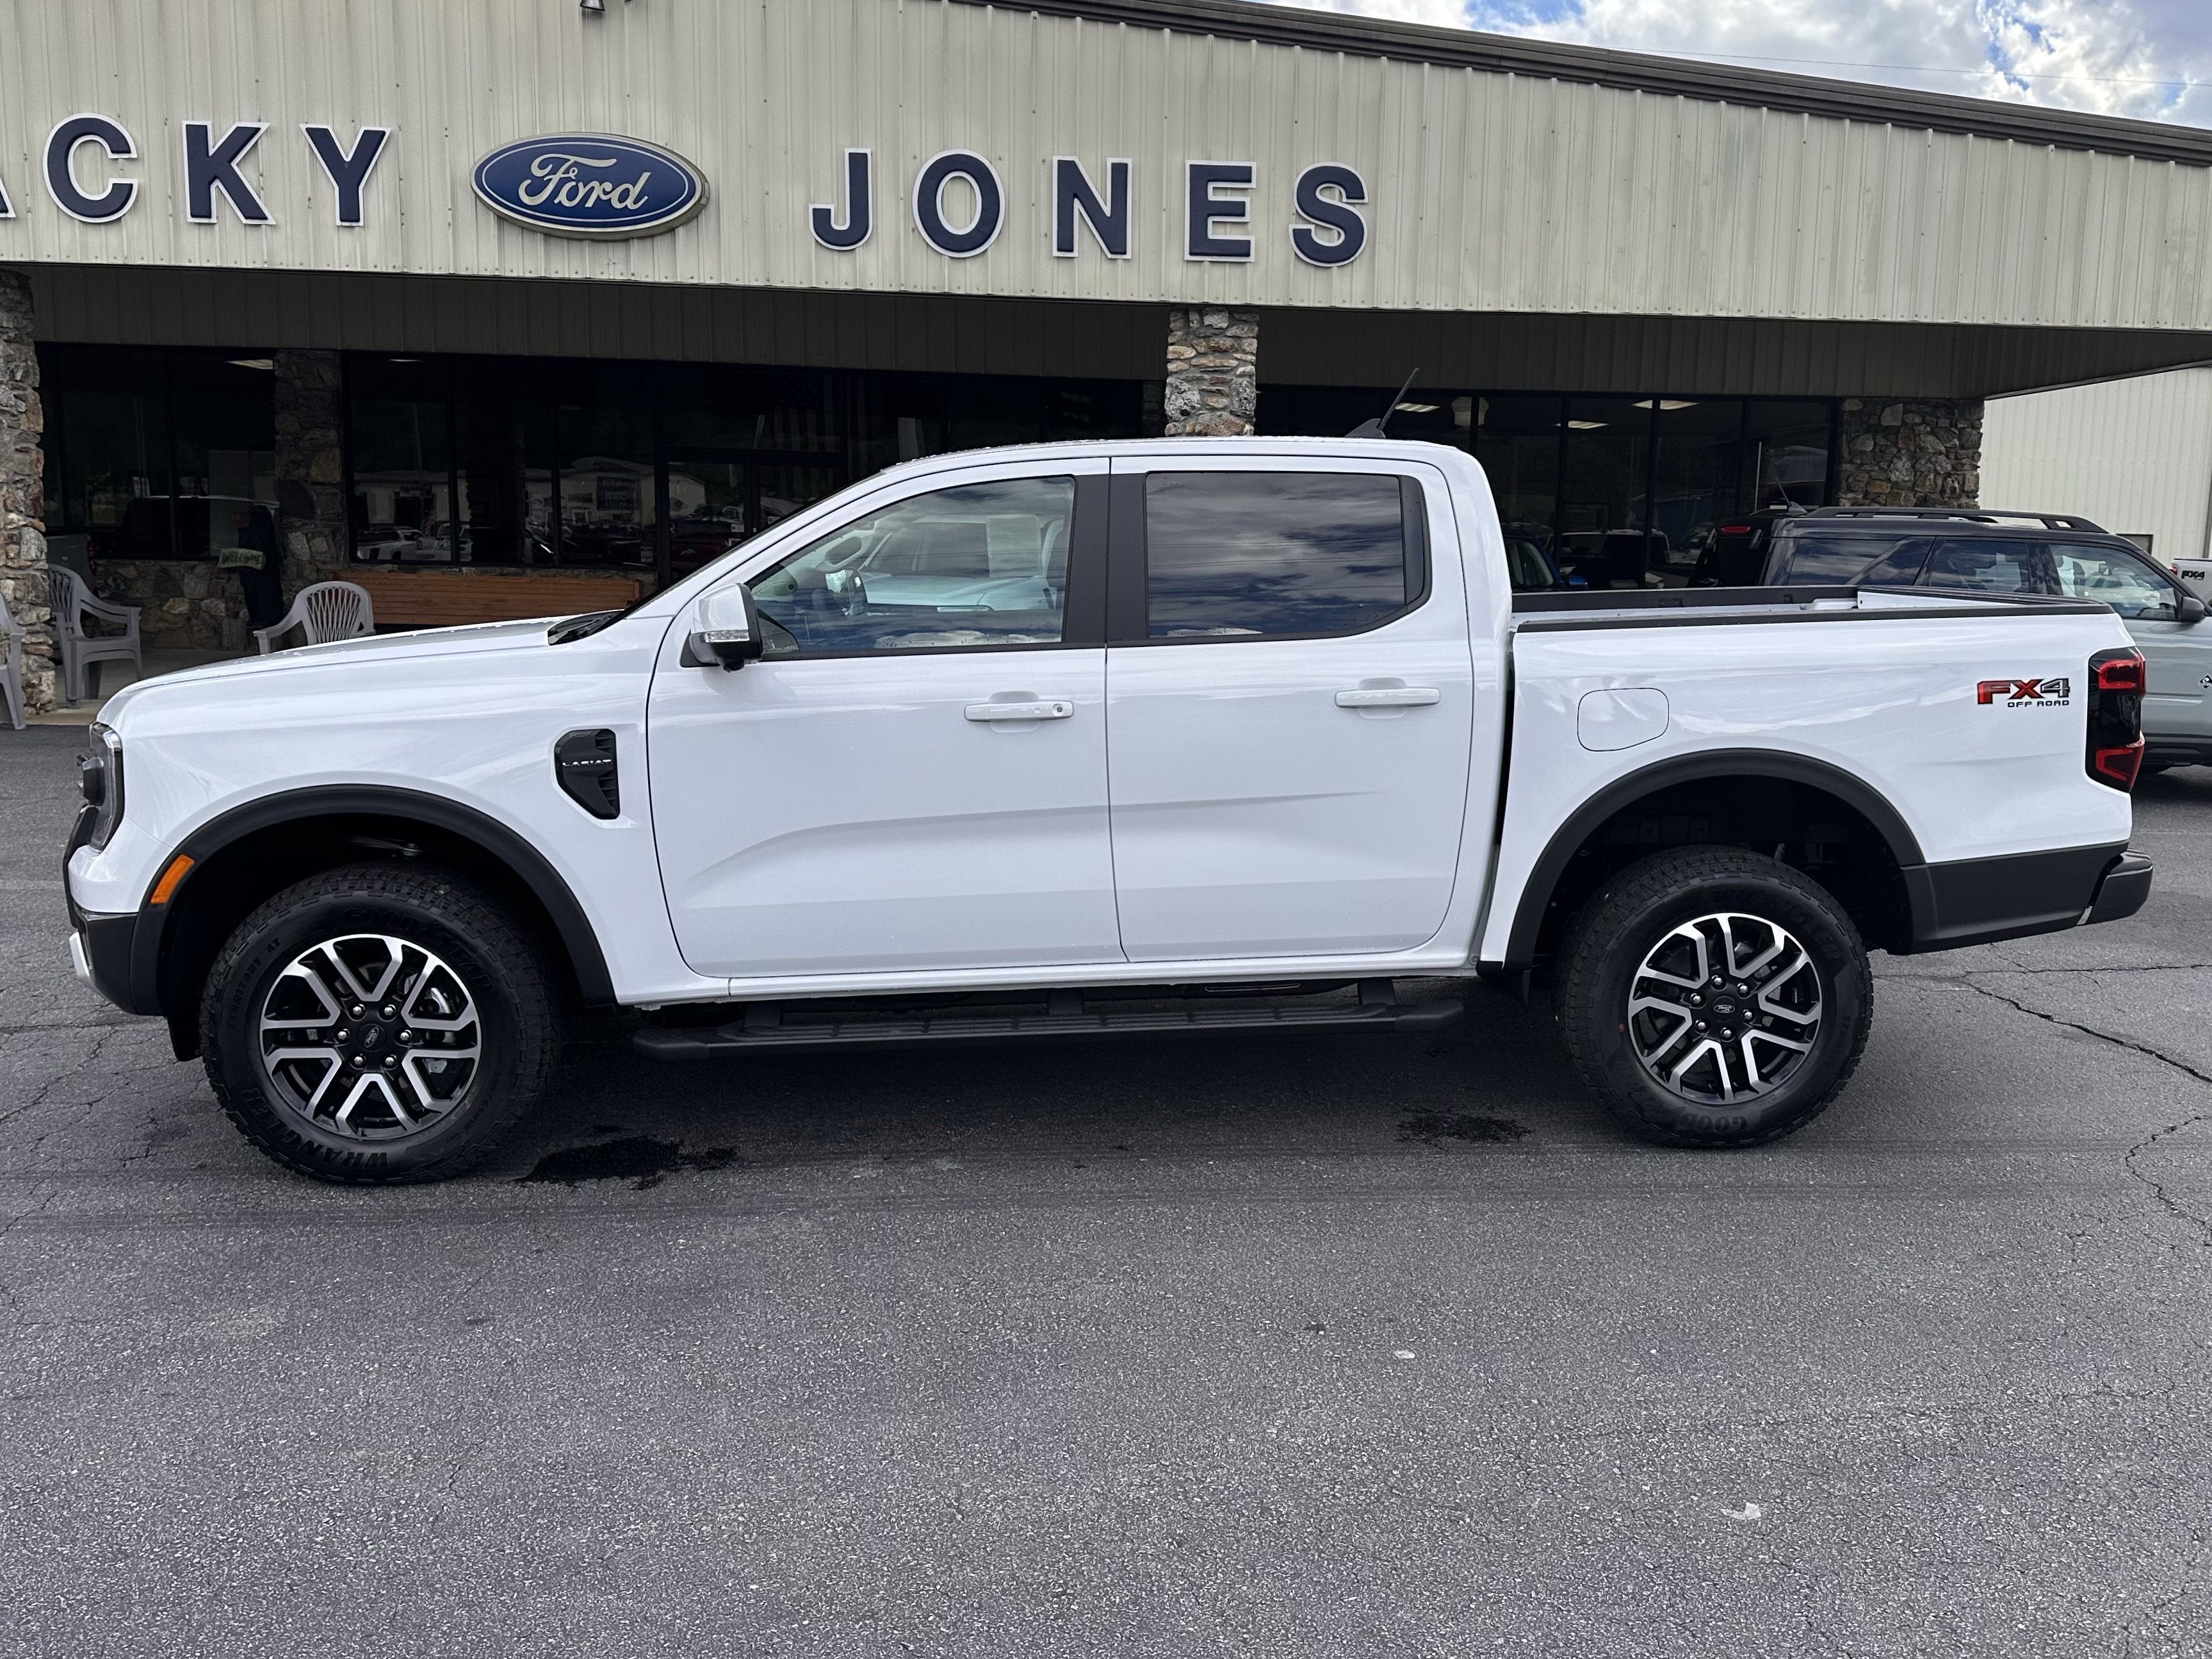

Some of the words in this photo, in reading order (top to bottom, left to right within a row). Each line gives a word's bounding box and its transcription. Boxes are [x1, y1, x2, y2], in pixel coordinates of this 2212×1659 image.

[0, 111, 392, 227] CKY
[518, 153, 652, 210] Ford
[808, 147, 1368, 268] JONES
[1977, 678, 2070, 705] FX4
